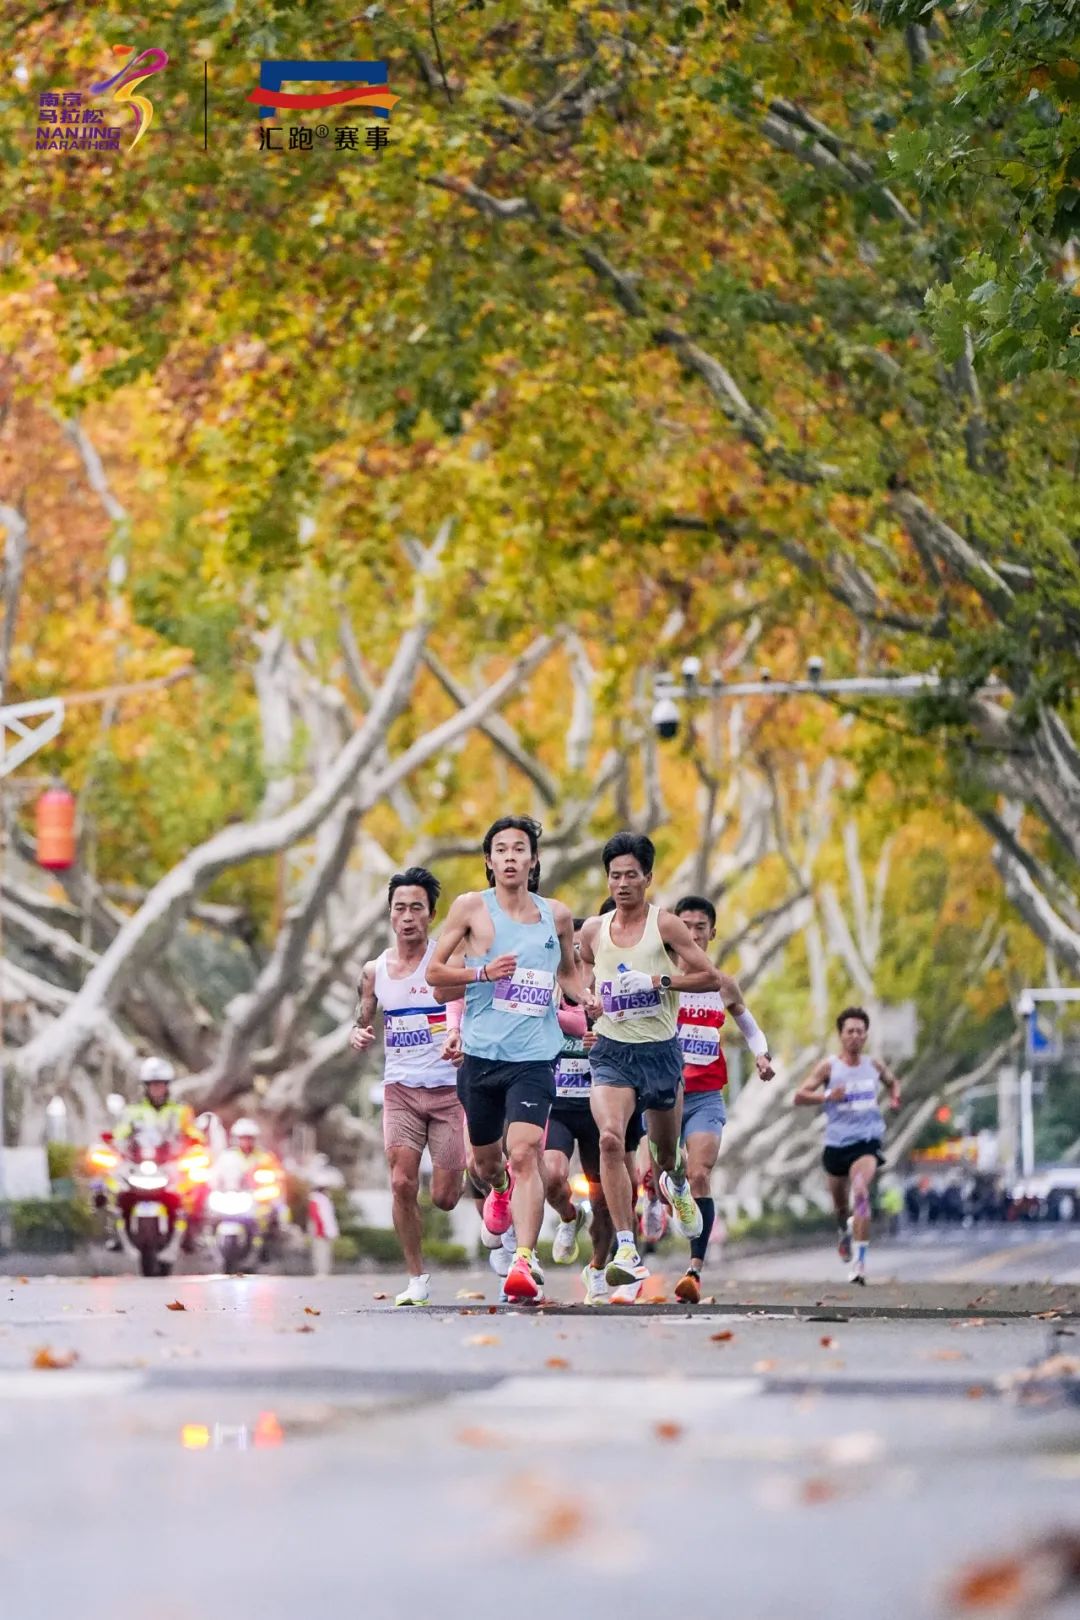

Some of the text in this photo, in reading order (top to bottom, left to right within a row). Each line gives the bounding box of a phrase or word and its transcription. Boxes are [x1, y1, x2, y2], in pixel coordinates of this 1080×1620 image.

[510, 985, 551, 1005] 26049
[603, 984, 611, 994] A
[614, 993, 655, 1010] 17532
[393, 1030, 429, 1047] 24003
[680, 1039, 717, 1056] 14657
